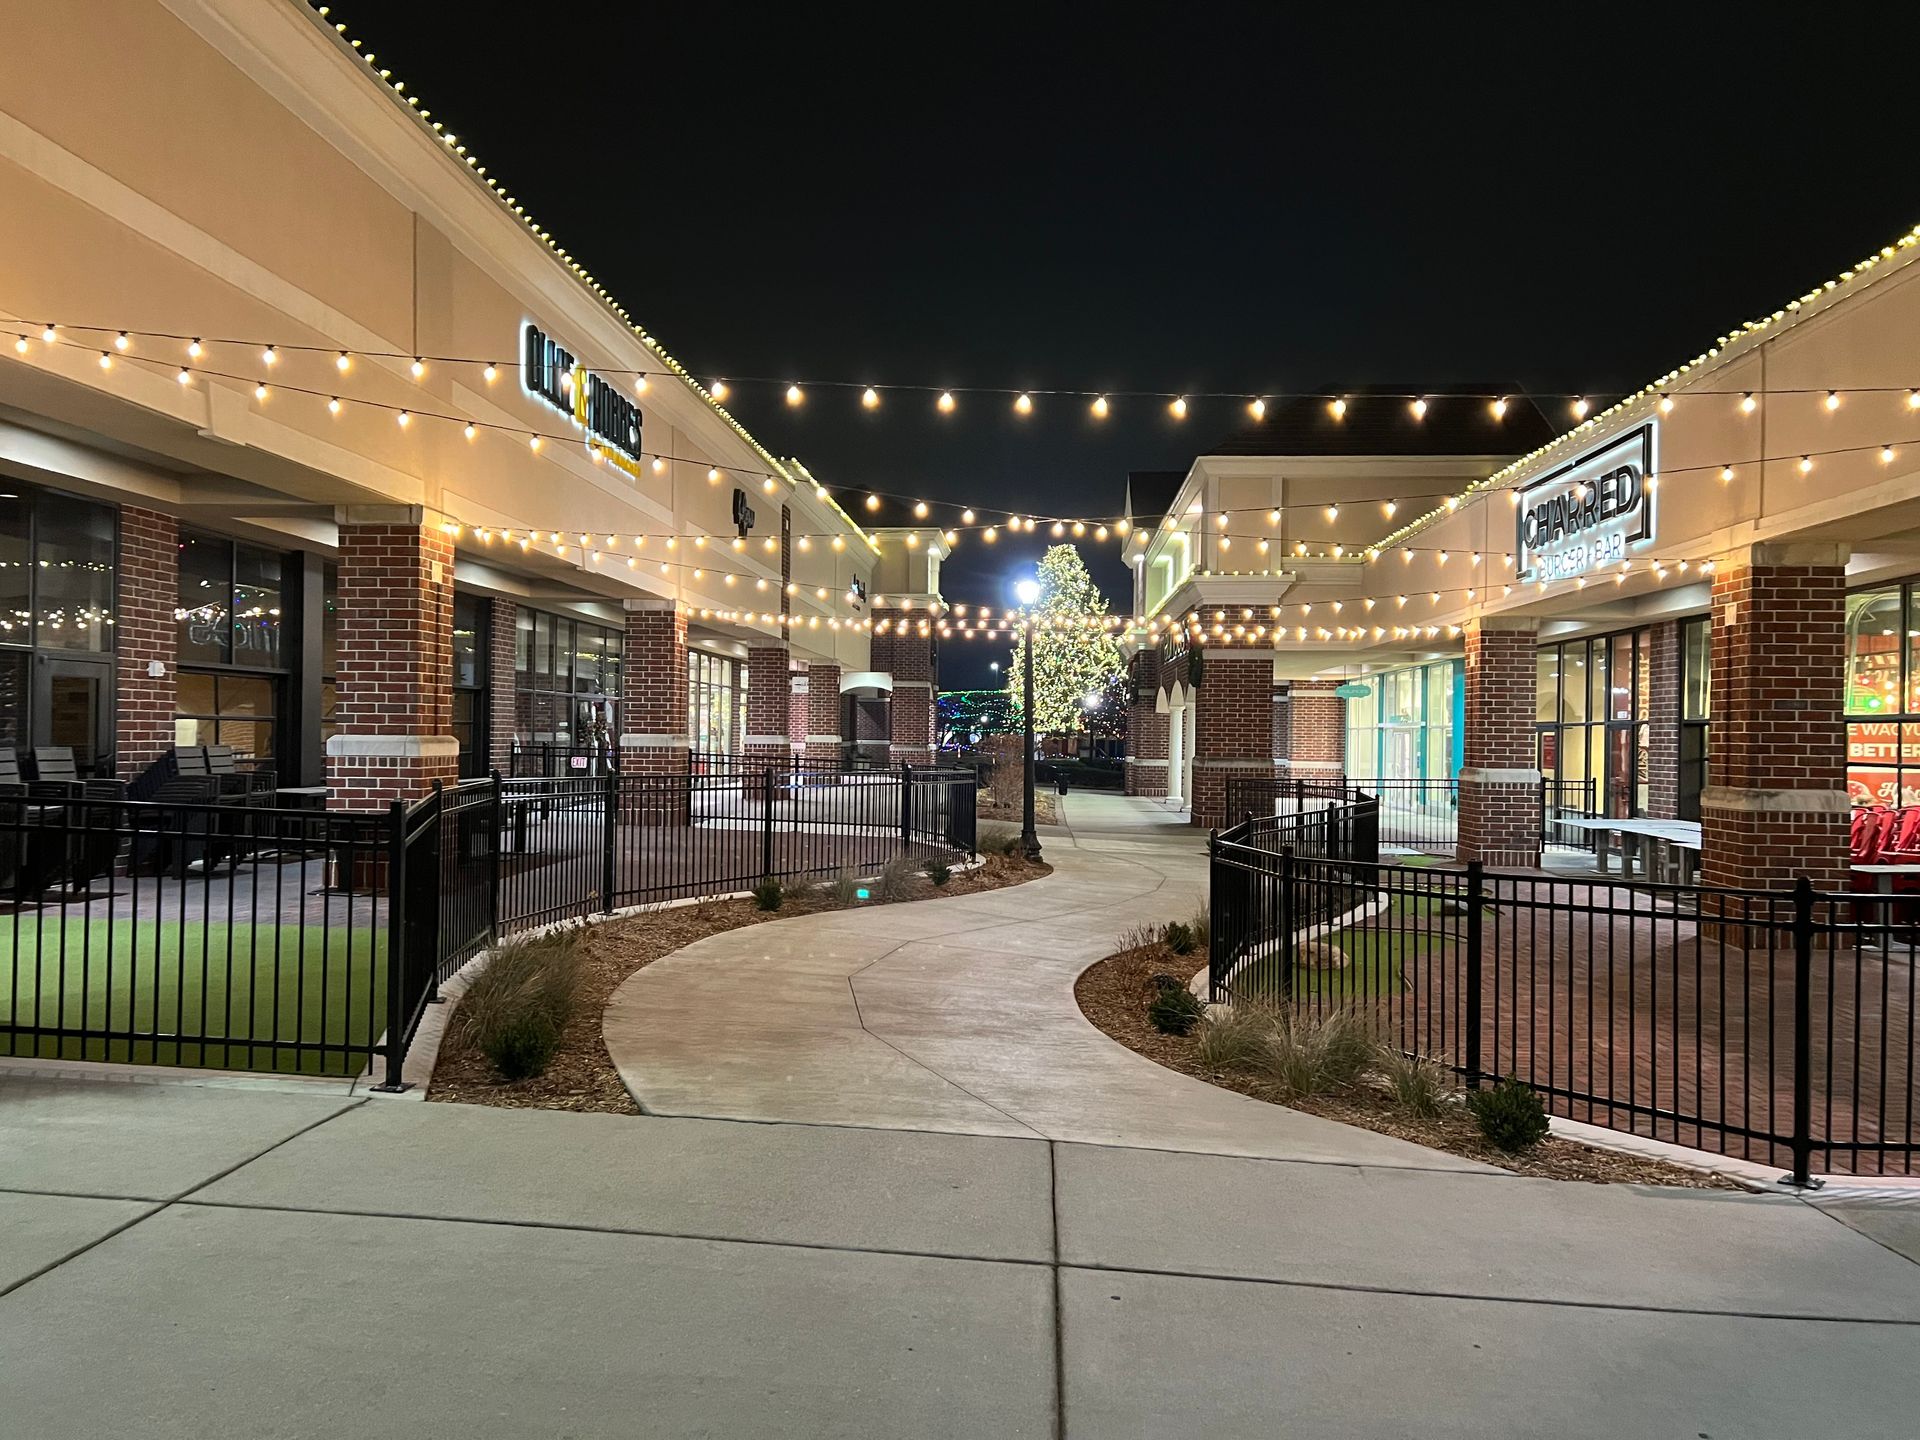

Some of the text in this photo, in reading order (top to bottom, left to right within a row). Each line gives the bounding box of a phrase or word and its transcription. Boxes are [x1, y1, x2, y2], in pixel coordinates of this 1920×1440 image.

[1523, 463, 1644, 550] CHARRED
[1540, 546, 1584, 579] BURGER
[1594, 533, 1622, 561] BAR
[573, 757, 585, 767] EXIT
